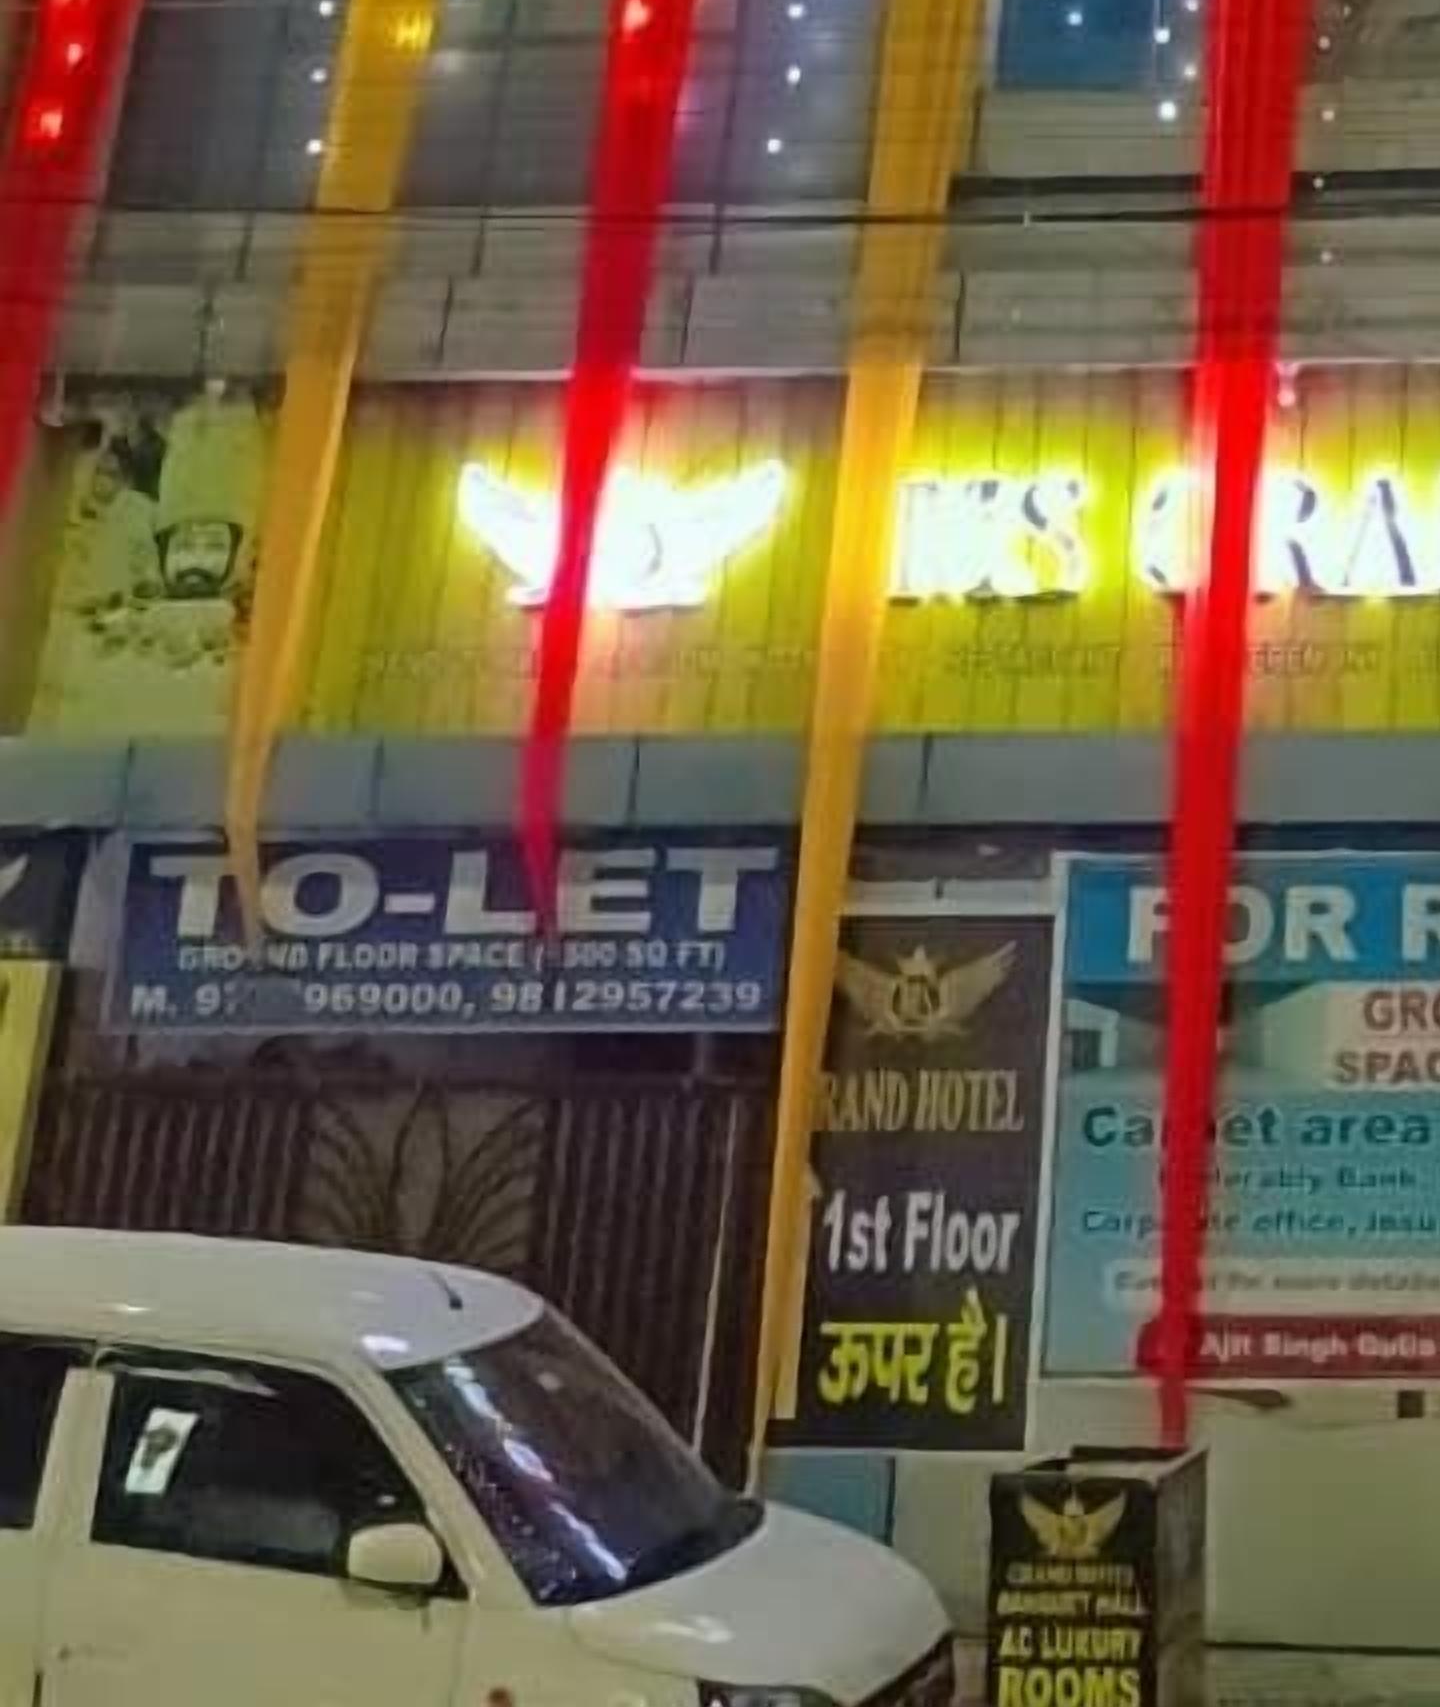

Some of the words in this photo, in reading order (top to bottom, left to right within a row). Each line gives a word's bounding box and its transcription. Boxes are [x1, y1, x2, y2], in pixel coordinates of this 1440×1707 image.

[150, 846, 778, 937] TO-LET
[317, 941, 419, 970] FLOOR
[427, 941, 526, 968] SPACE
[916, 1070, 1024, 1132] HOTEL
[1301, 1114, 1431, 1146] area
[823, 1190, 890, 1273] 1st
[904, 1189, 1020, 1273] Floor
[817, 1321, 940, 1403] ऊपर
[998, 1666, 1142, 1706] ROOMS
